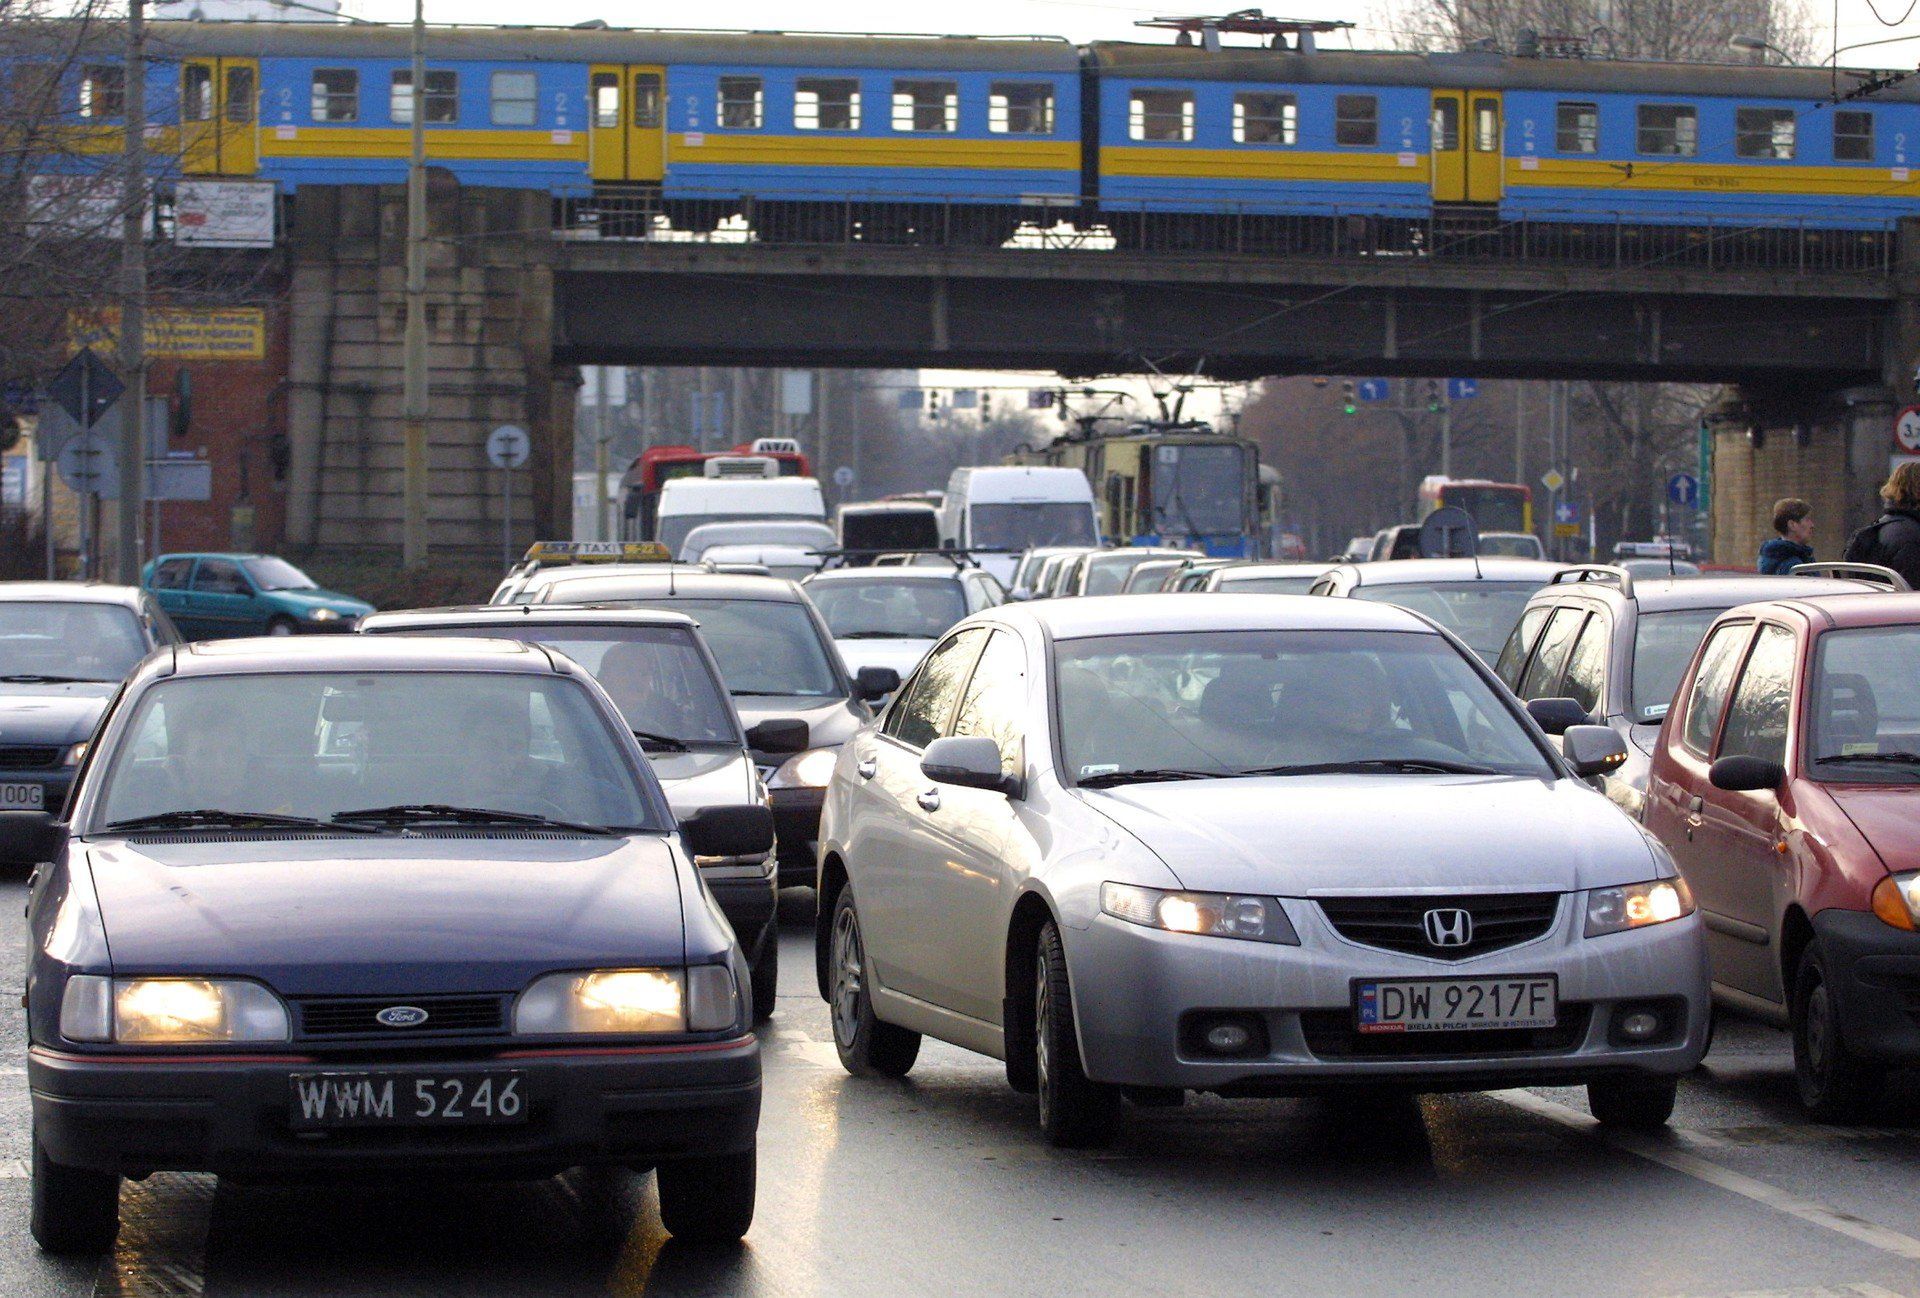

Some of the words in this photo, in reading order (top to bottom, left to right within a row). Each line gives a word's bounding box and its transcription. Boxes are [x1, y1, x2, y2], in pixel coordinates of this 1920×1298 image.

[555, 92, 567, 111] 2
[1523, 119, 1536, 138] 2
[1894, 133, 1906, 151] 2
[583, 543, 618, 553] TAXI
[0, 785, 41, 804] 00G
[1382, 986, 1431, 1020] DW
[1445, 982, 1549, 1018] 9217F
[1362, 1007, 1375, 1018] PL
[298, 1079, 394, 1119] WWM
[415, 1077, 520, 1118] 5246
